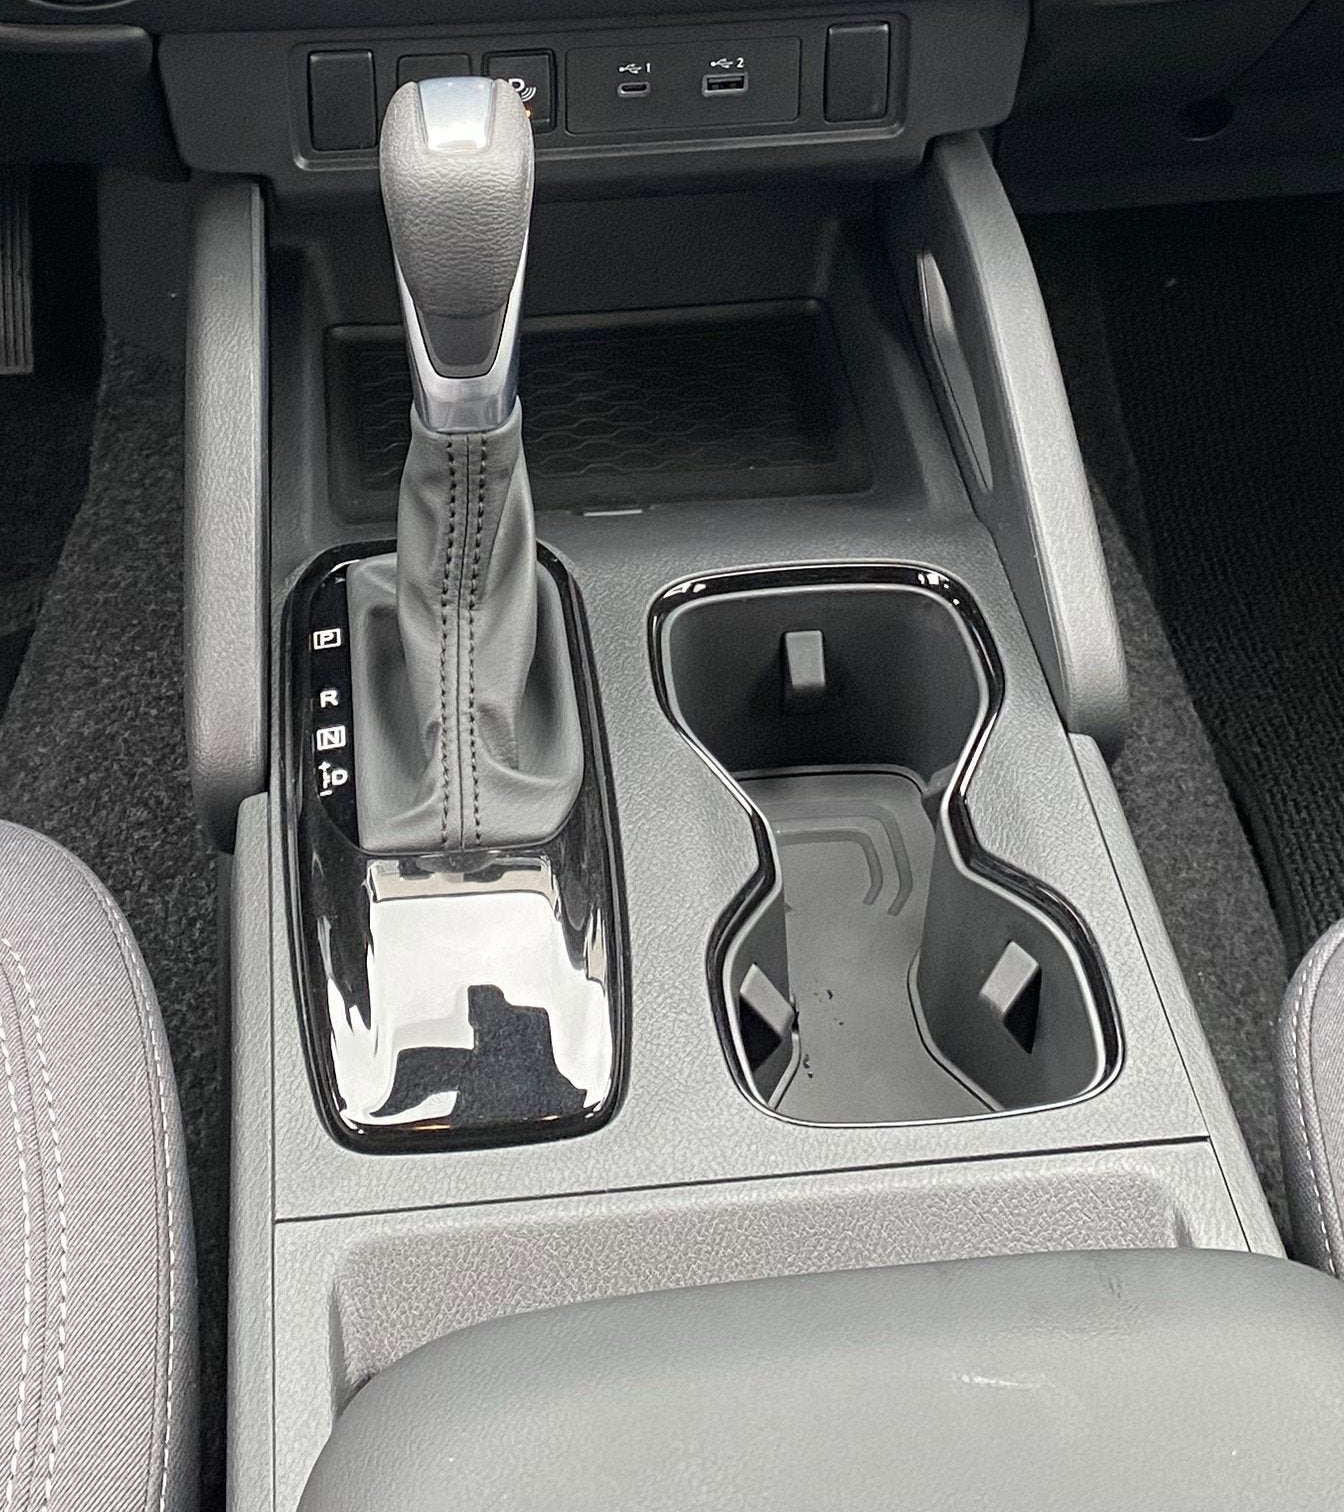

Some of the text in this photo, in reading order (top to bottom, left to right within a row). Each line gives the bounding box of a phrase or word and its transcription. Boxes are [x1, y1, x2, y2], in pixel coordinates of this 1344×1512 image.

[736, 57, 744, 69] 2
[320, 690, 339, 707] R
[332, 769, 348, 785] D
